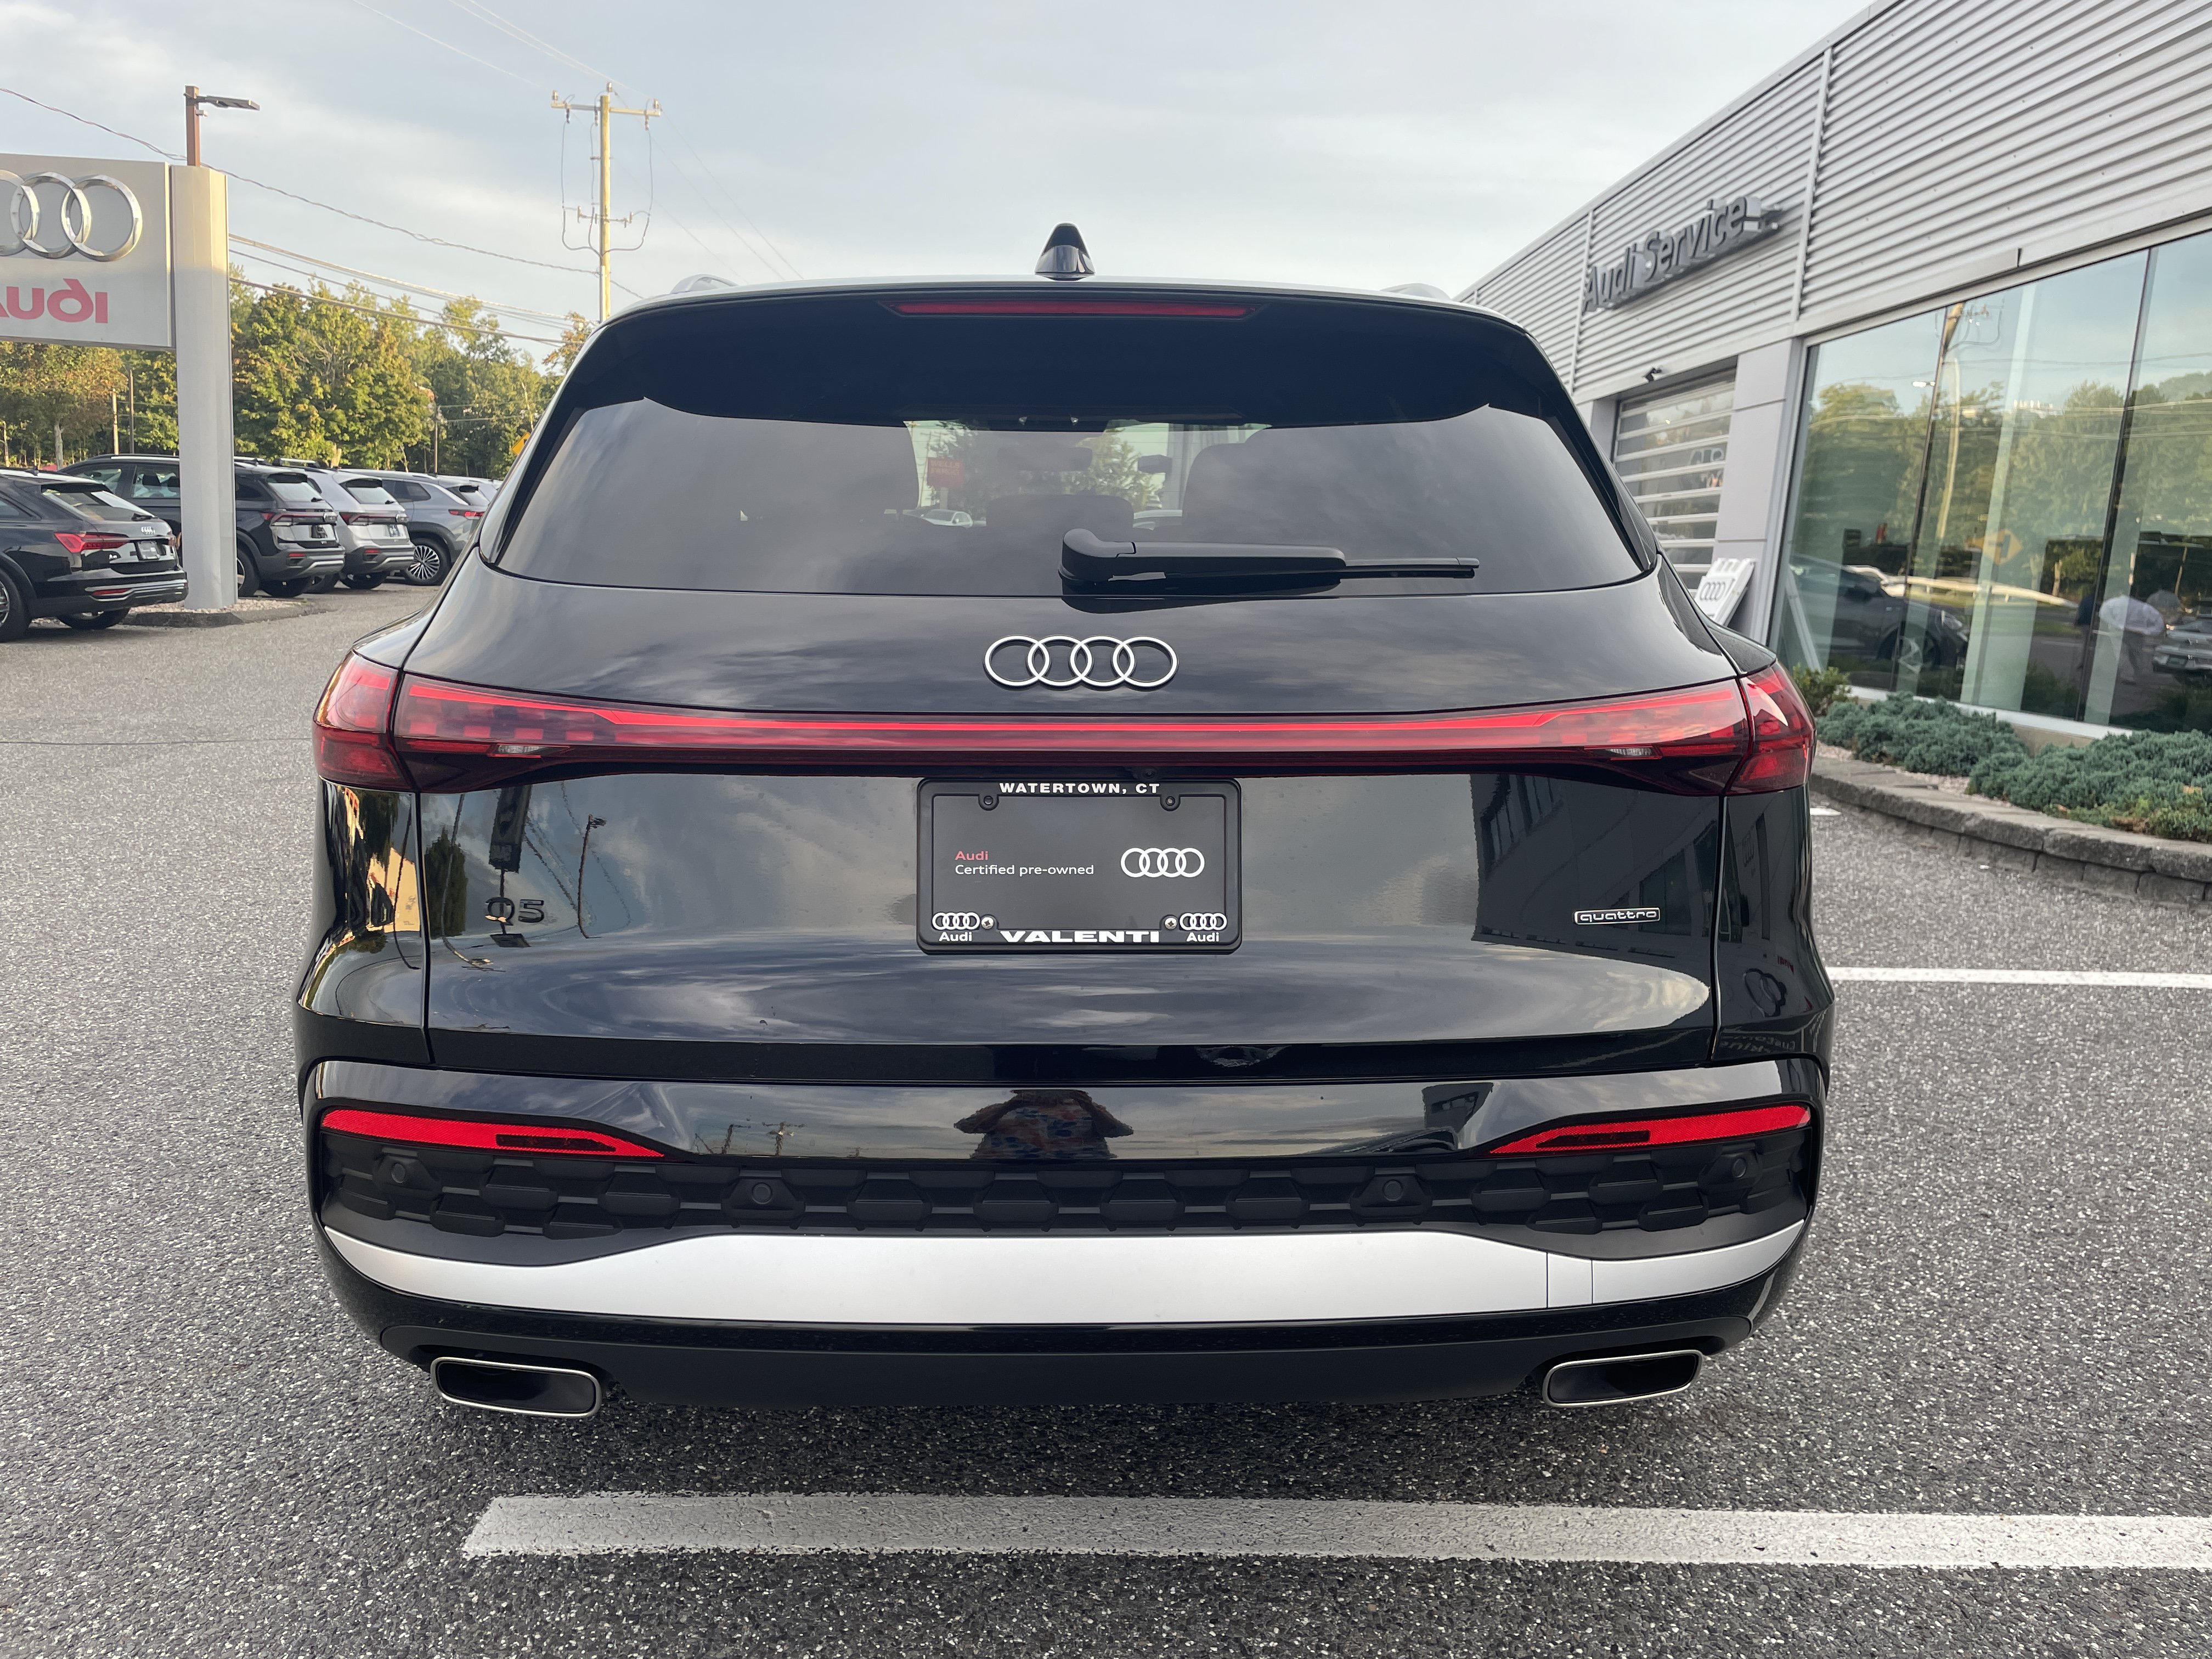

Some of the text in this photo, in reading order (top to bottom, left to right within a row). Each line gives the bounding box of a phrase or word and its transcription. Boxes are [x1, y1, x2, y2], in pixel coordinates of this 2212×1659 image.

[1582, 197, 1761, 316] Audi Service
[0, 278, 108, 323] udi
[999, 783, 1160, 794] WATERTOWN, CT
[955, 851, 989, 861] Audi
[955, 865, 1094, 877] Certified pre-owned
[486, 897, 545, 926] Q5
[1580, 911, 1657, 923] quattro
[939, 932, 973, 941] Audi
[1000, 930, 1159, 943] VALENTI
[1186, 932, 1220, 942] Audi
